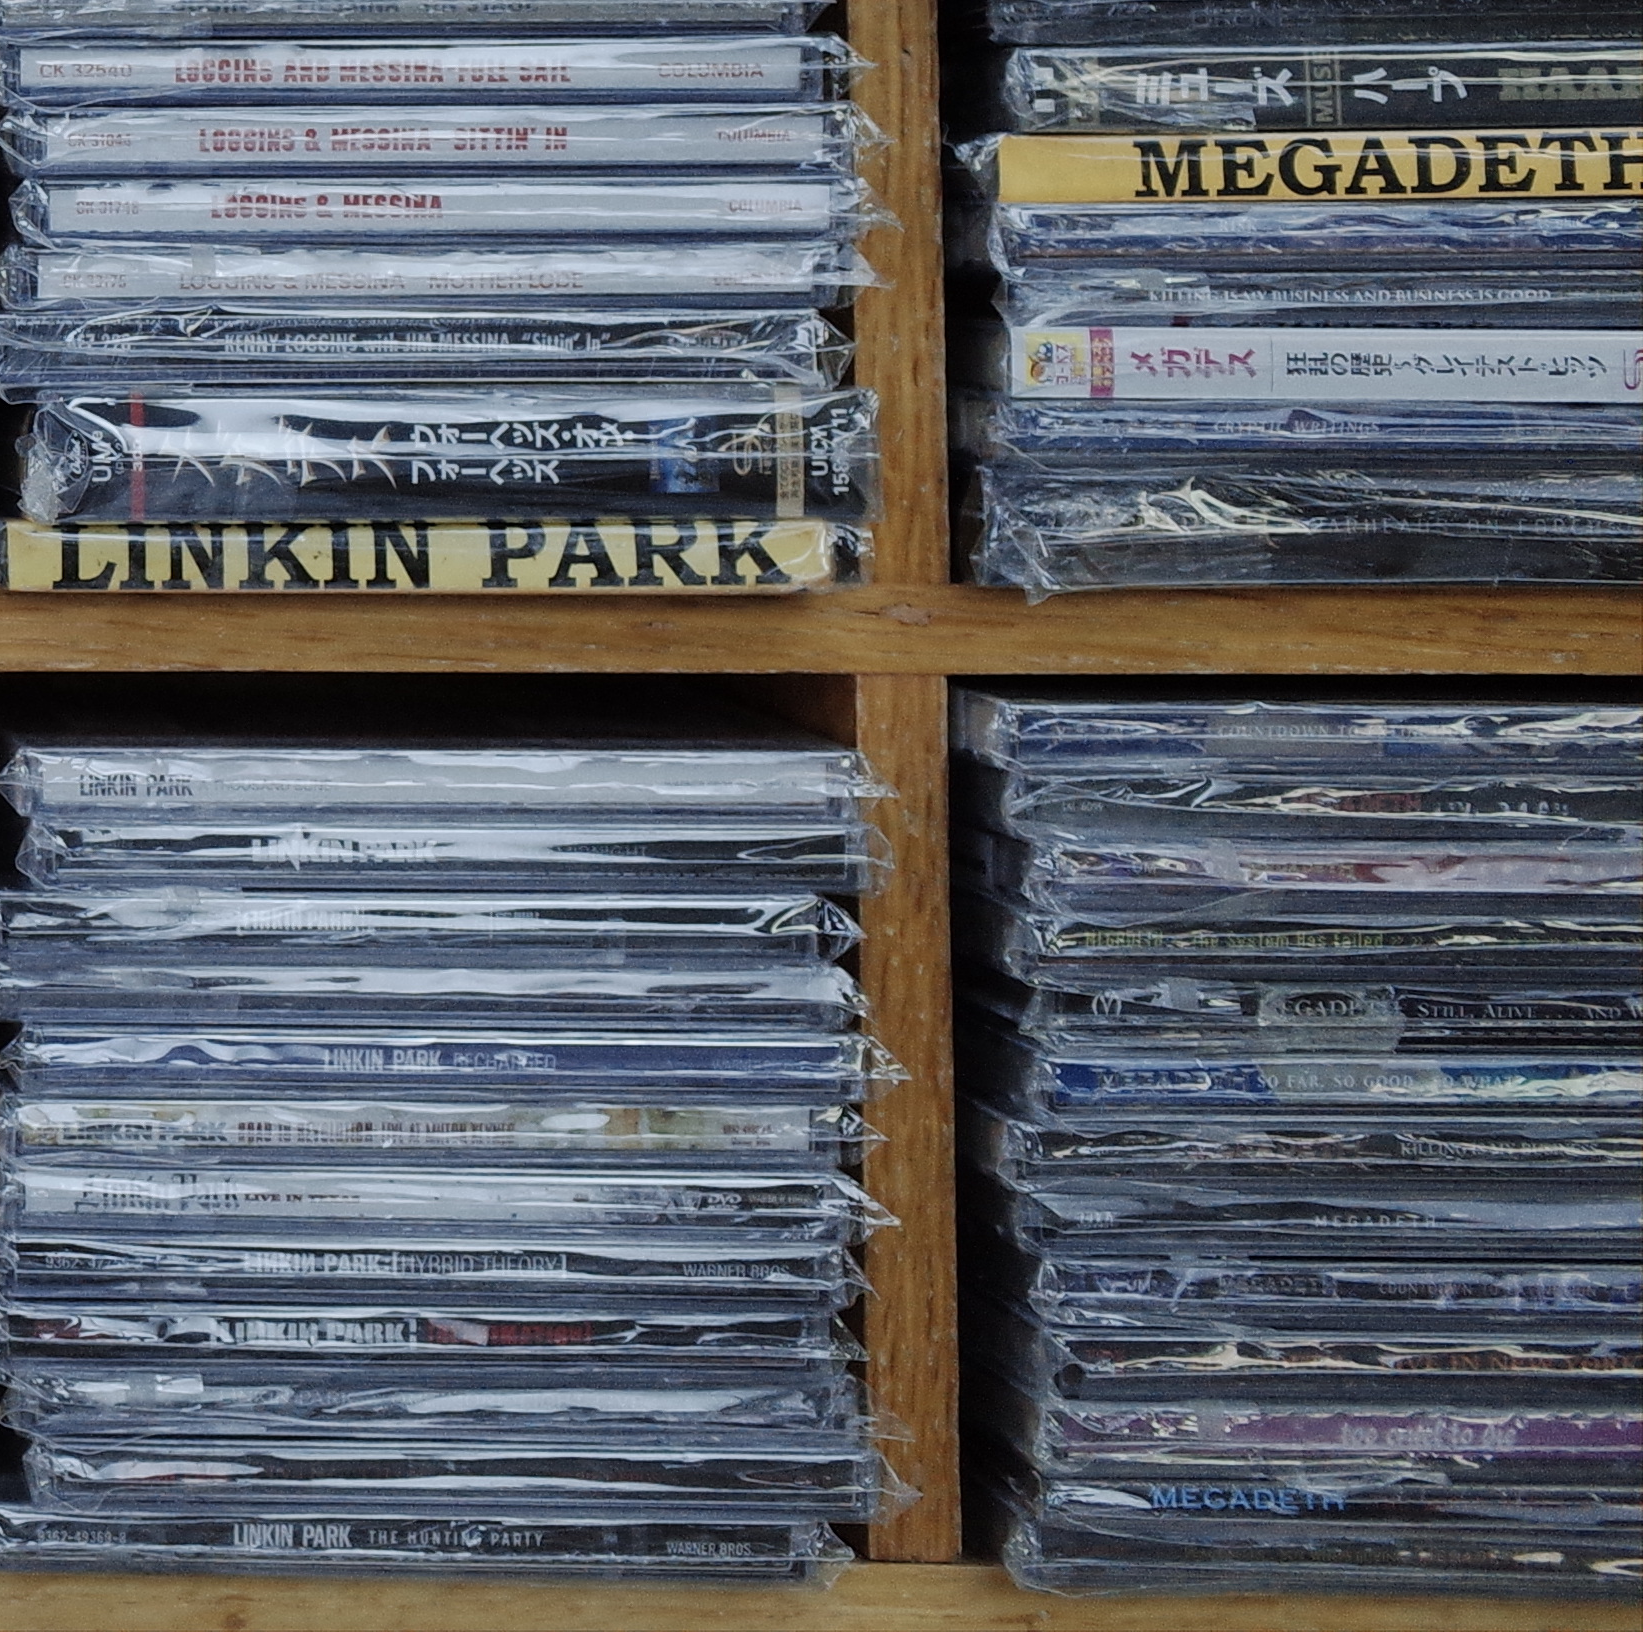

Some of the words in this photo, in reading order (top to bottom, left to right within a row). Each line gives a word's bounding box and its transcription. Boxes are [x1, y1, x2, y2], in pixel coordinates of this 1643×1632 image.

[1133, 132, 1643, 200] MEGADETH
[52, 519, 436, 591] LINKIN
[483, 517, 792, 589] PARK
[232, 1524, 295, 1549] LINKIN
[300, 1525, 352, 1549] PARK
